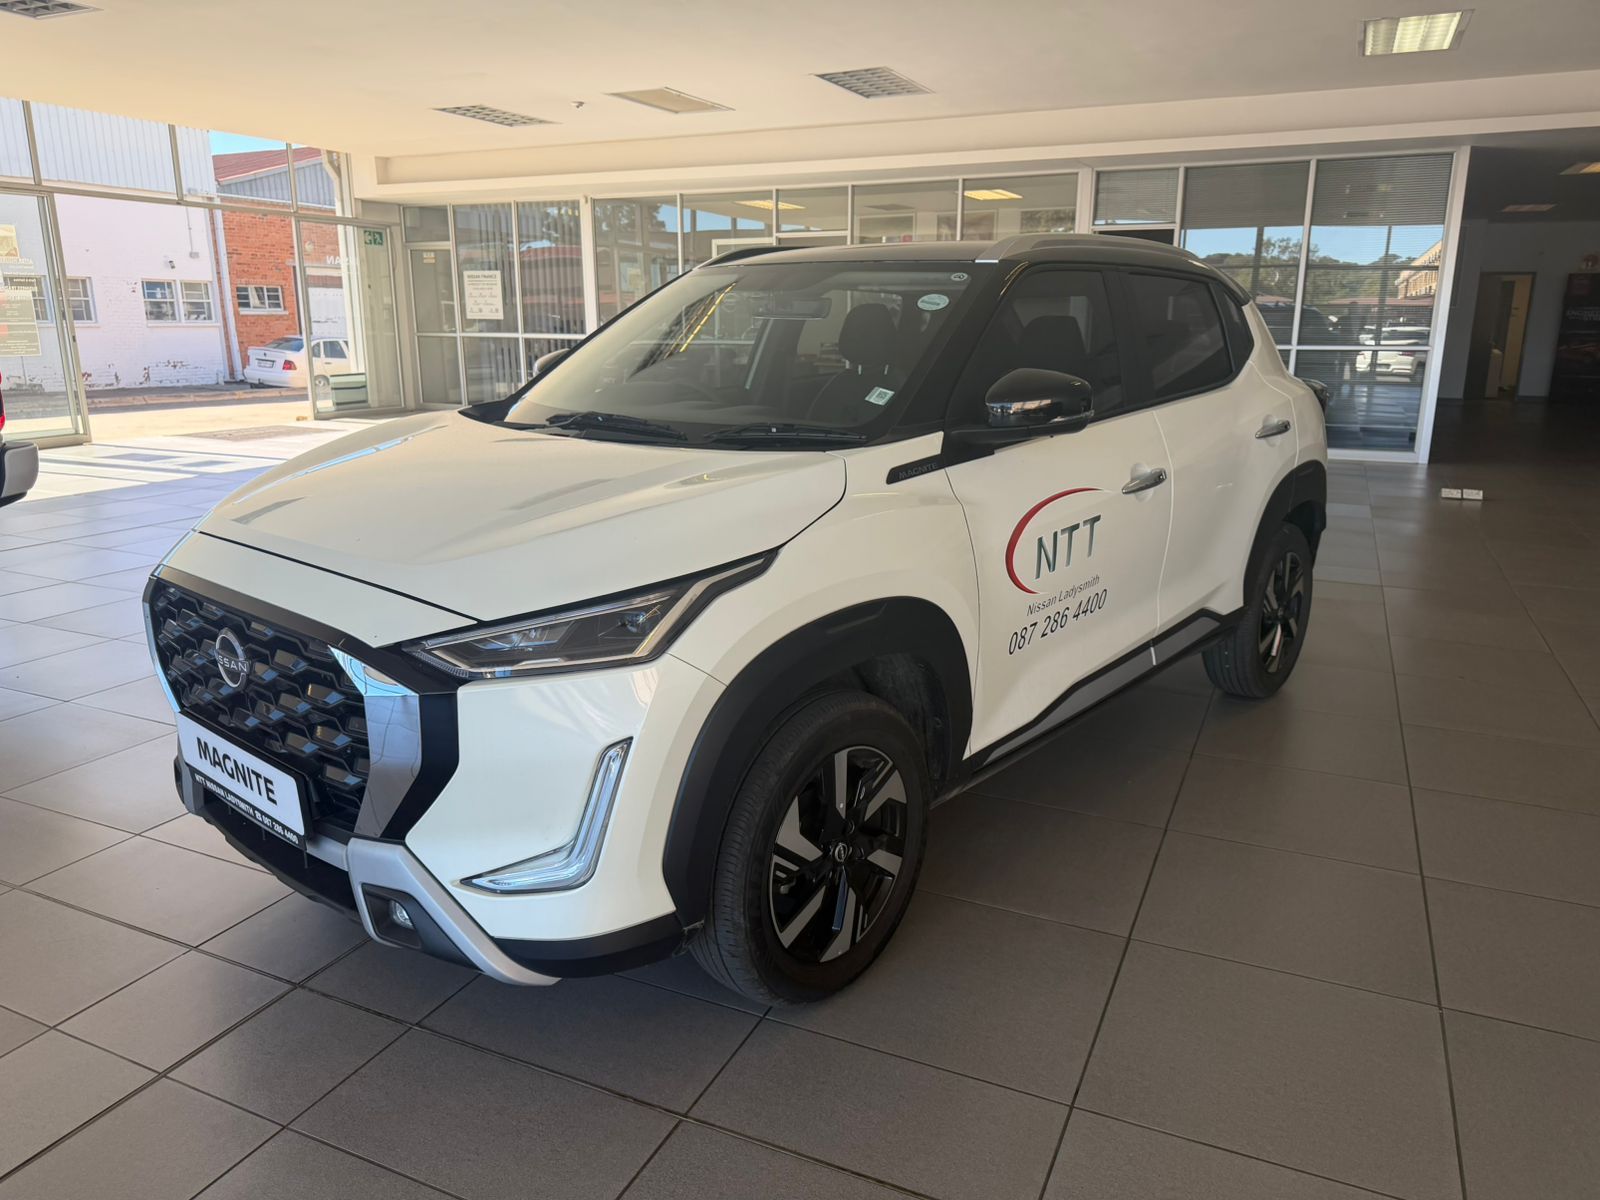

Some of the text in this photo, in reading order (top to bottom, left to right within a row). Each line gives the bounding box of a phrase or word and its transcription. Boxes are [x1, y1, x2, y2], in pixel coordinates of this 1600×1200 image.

[898, 462, 938, 479] MAGNITE
[1035, 514, 1102, 580] NTT
[1008, 588, 1108, 656] 087 286 4400
[1027, 574, 1101, 617] Nissan Ladysmith
[217, 655, 247, 672] SSAN
[196, 736, 278, 806] MAGNITE
